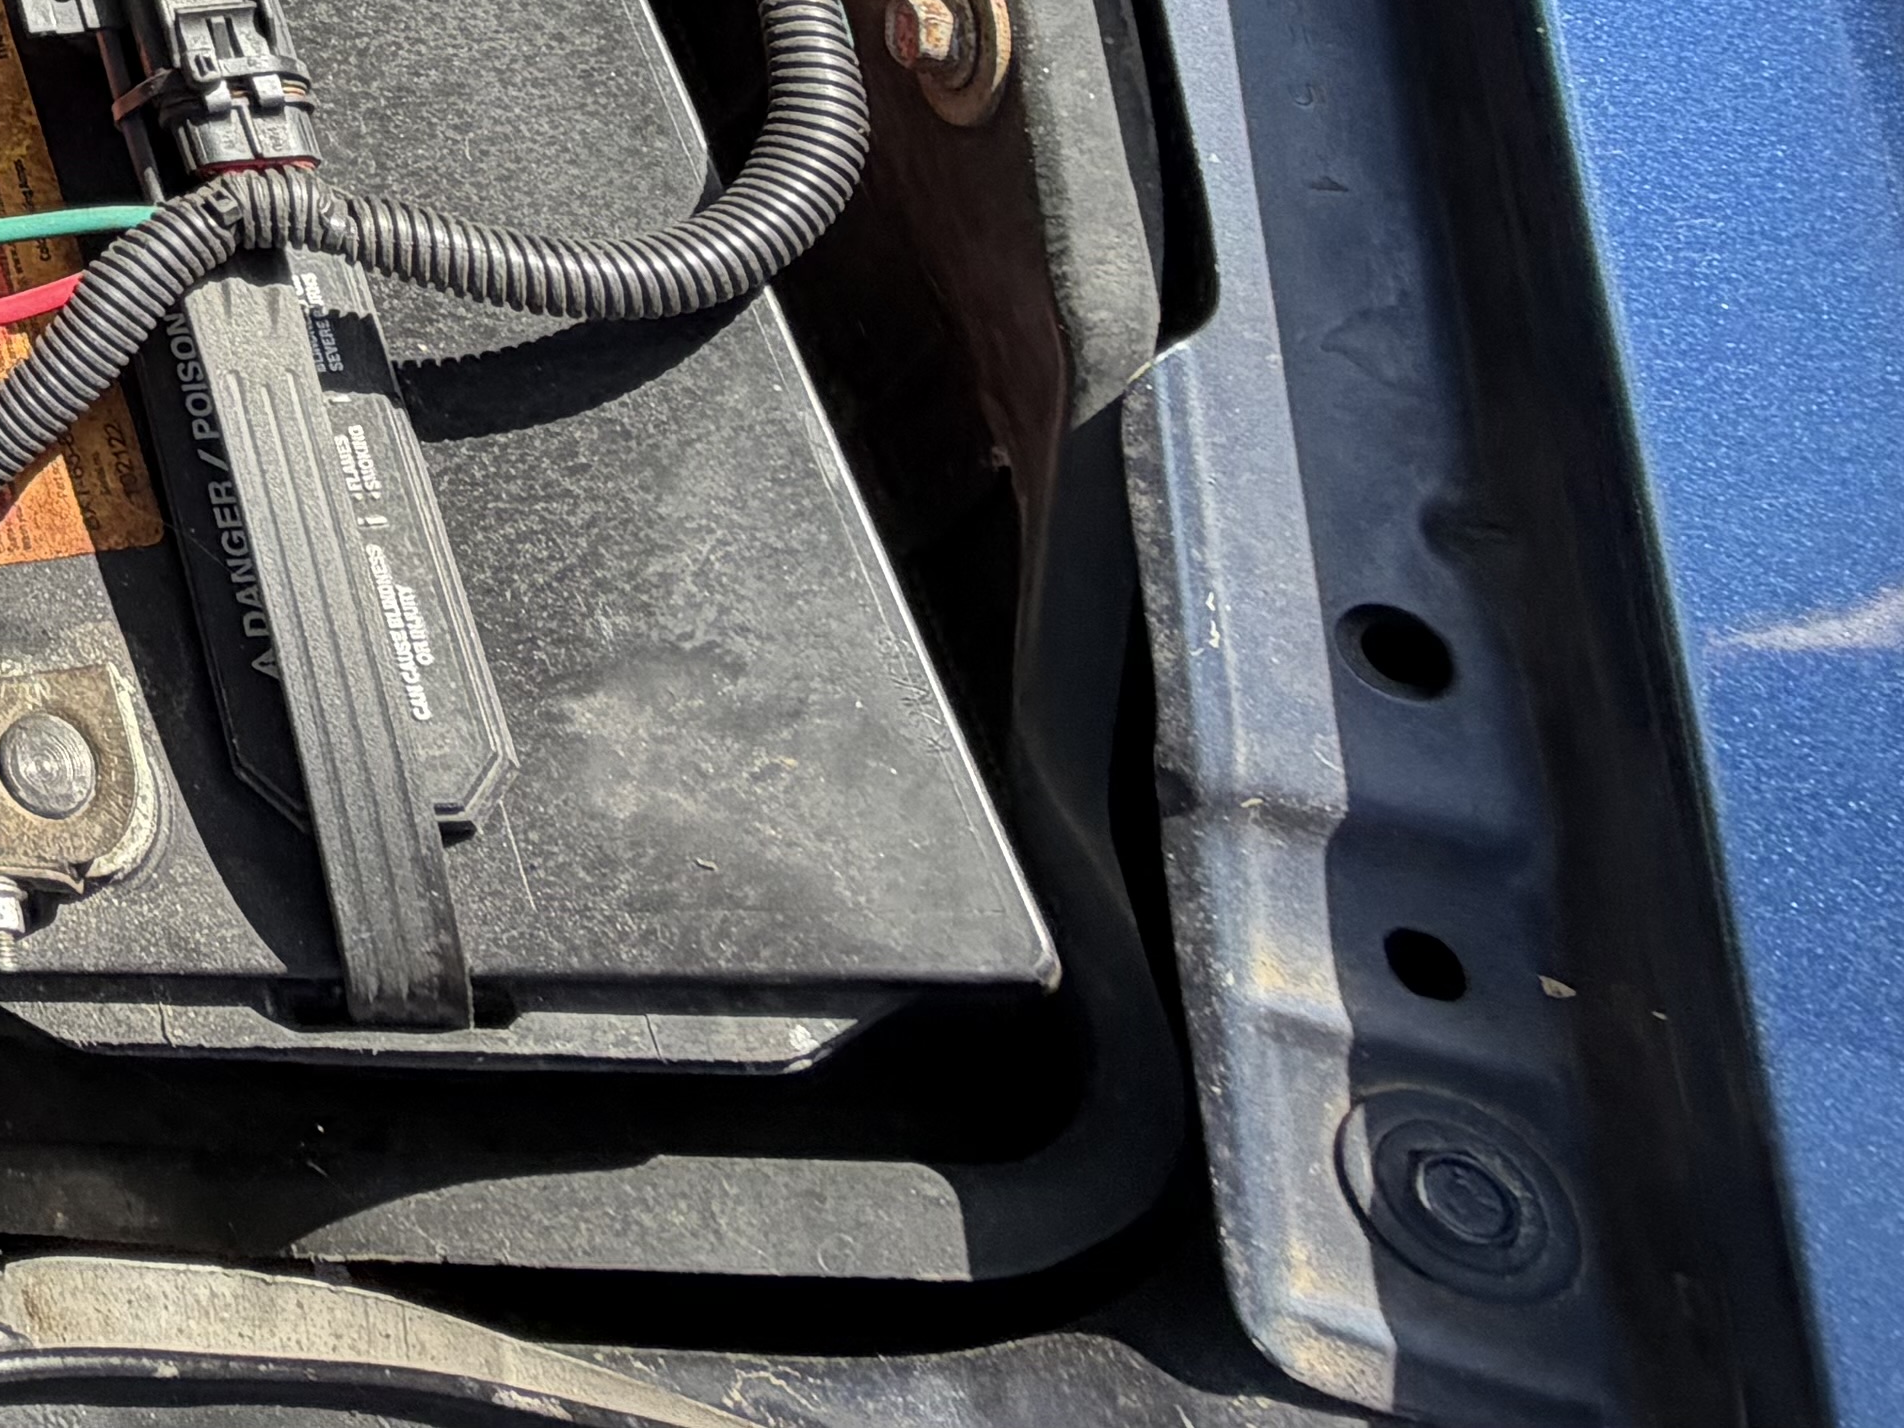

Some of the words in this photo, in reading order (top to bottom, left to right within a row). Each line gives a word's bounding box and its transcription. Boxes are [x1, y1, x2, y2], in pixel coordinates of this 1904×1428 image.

[164, 313, 222, 444] POISON
[208, 480, 270, 640] DANGER
[366, 544, 404, 629] BLINDNESS
